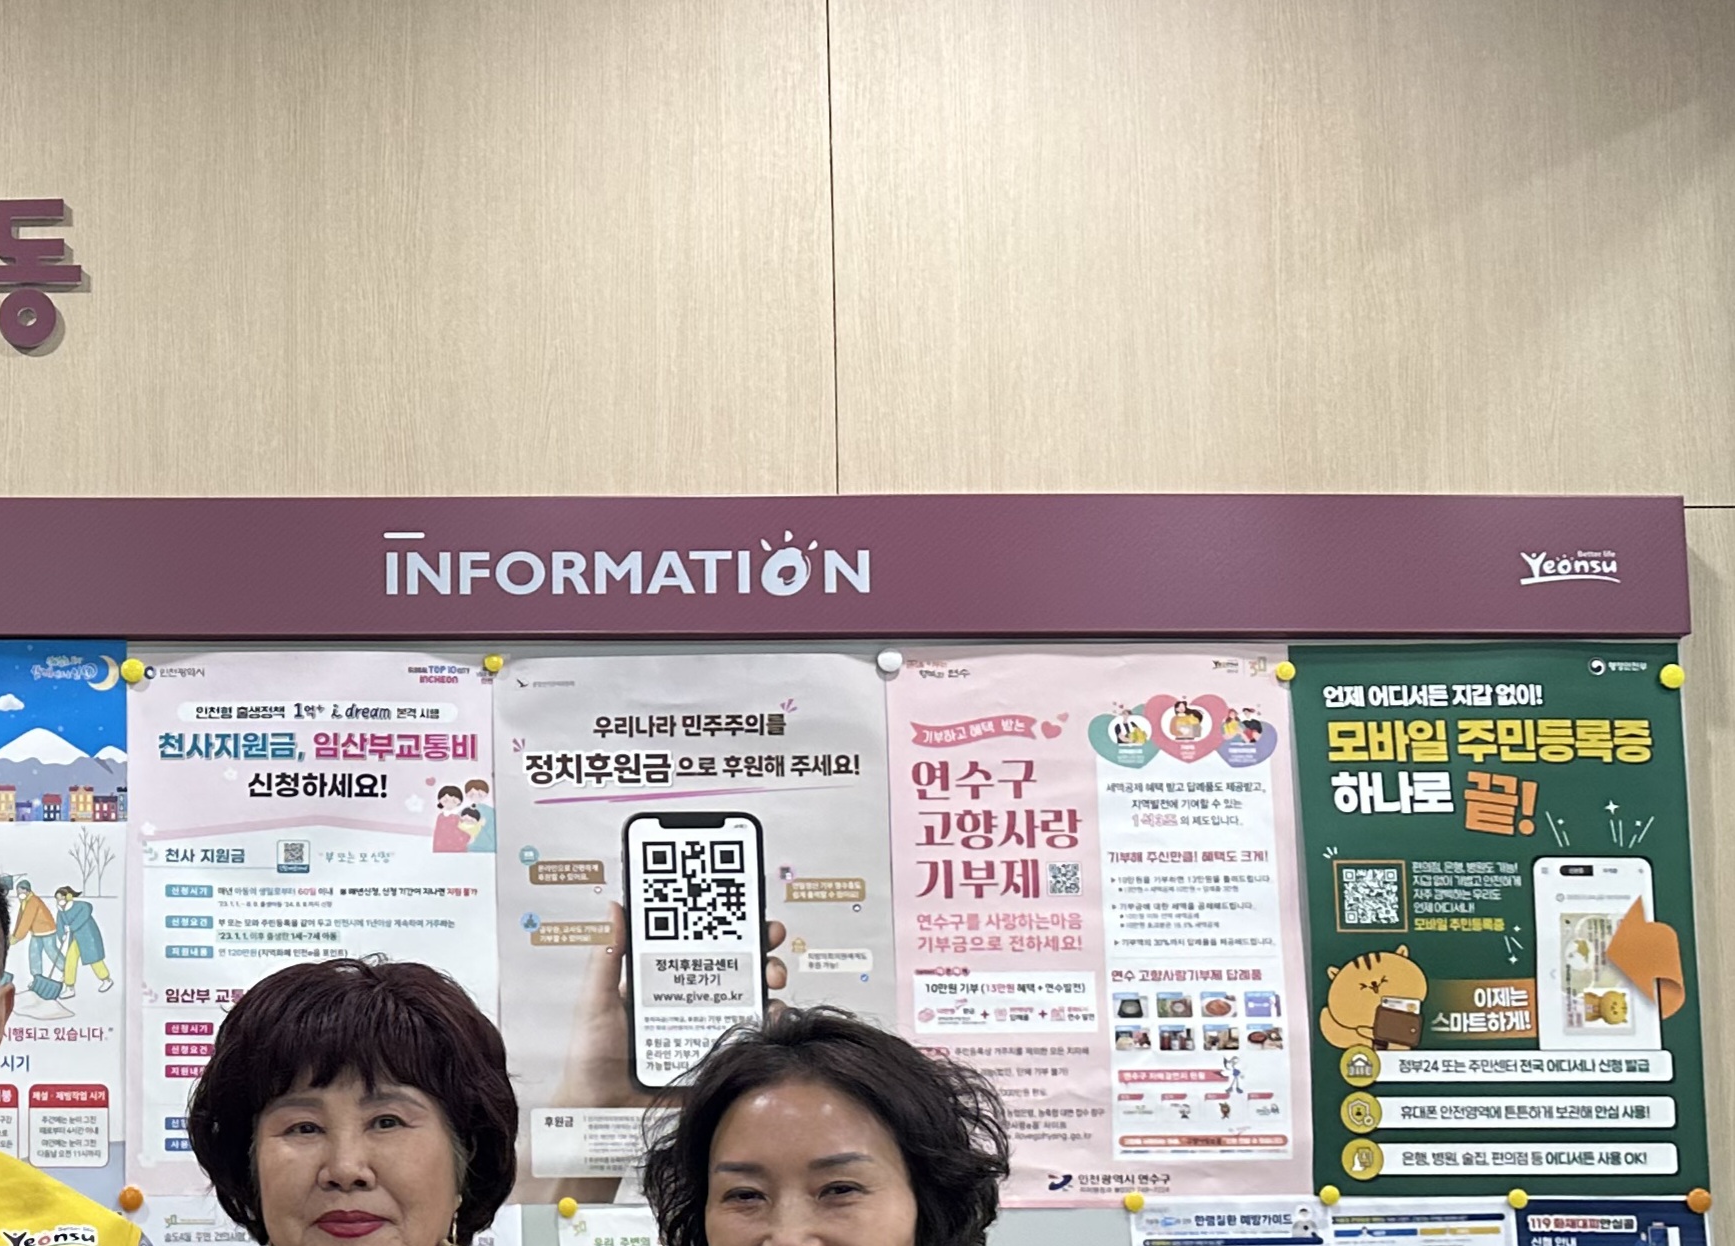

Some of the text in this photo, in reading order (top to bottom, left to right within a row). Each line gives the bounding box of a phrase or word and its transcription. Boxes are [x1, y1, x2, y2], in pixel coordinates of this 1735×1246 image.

[383, 531, 870, 596] INFORMATION
[1521, 551, 1617, 578] Yeonsu
[428, 666, 446, 674] TOP
[420, 675, 458, 684] INCHEON
[1323, 684, 1543, 708] 언제 어디서든 지갑 없이!
[196, 707, 233, 719] 인천형
[237, 707, 285, 719] 출생정책
[346, 703, 392, 720] dream
[397, 707, 417, 719] 본격
[420, 707, 439, 719] 시행
[593, 714, 786, 738] 우리나라 민주주의를
[922, 719, 1026, 743] 기부하고 혜택 받는
[159, 732, 478, 761] 천사지원금, 임산부교통비
[1327, 719, 1652, 763] 모바일 주민등록증
[525, 753, 860, 784] 정치후원금 으로 후원해 주세요!
[248, 773, 387, 798] 신청하세요!
[912, 760, 1037, 801] 연수구
[1331, 771, 1539, 836] 하나로 끝!
[916, 809, 1082, 849] 고향사랑
[166, 848, 245, 863] 천사 지원금
[916, 859, 1039, 900] 기부제
[917, 914, 980, 930] 연수구를
[1414, 918, 1504, 931] 모바일 주민등록증
[918, 935, 1082, 953] 기부금으로 전하세요!
[656, 959, 738, 971] 정치후원금센터
[674, 974, 721, 985] 바로가기
[1111, 969, 1262, 983] 연수 고향사랑기부제 답례품
[165, 988, 210, 1003] 임산부
[926, 984, 957, 993] 10만원
[960, 983, 978, 994] 기부
[1018, 984, 1034, 993] 혜택
[654, 991, 742, 1004] www.give.go.kr
[1474, 988, 1528, 1008] 이제는
[1431, 1011, 1532, 1032] 스마트하게!
[1, 1055, 29, 1072] 시기
[1399, 1059, 1650, 1072] 정부24 또는 주민센터 전국 어디서나 신청 발급
[1401, 1106, 1650, 1119] 휴대폰 안전영역에 튼튼하게 보관해 안심 사용!
[544, 1117, 574, 1127] 후원금
[1402, 1152, 1647, 1165] 은행, 병원, 술집, 편의점 등 어디서든 사용 OK!
[1079, 1173, 1171, 1185] 인천광역시 연수구
[1240, 1214, 1293, 1226] 예방가이드
[1531, 1218, 1550, 1229] 119
[620, 1237, 650, 1246] 주변의
